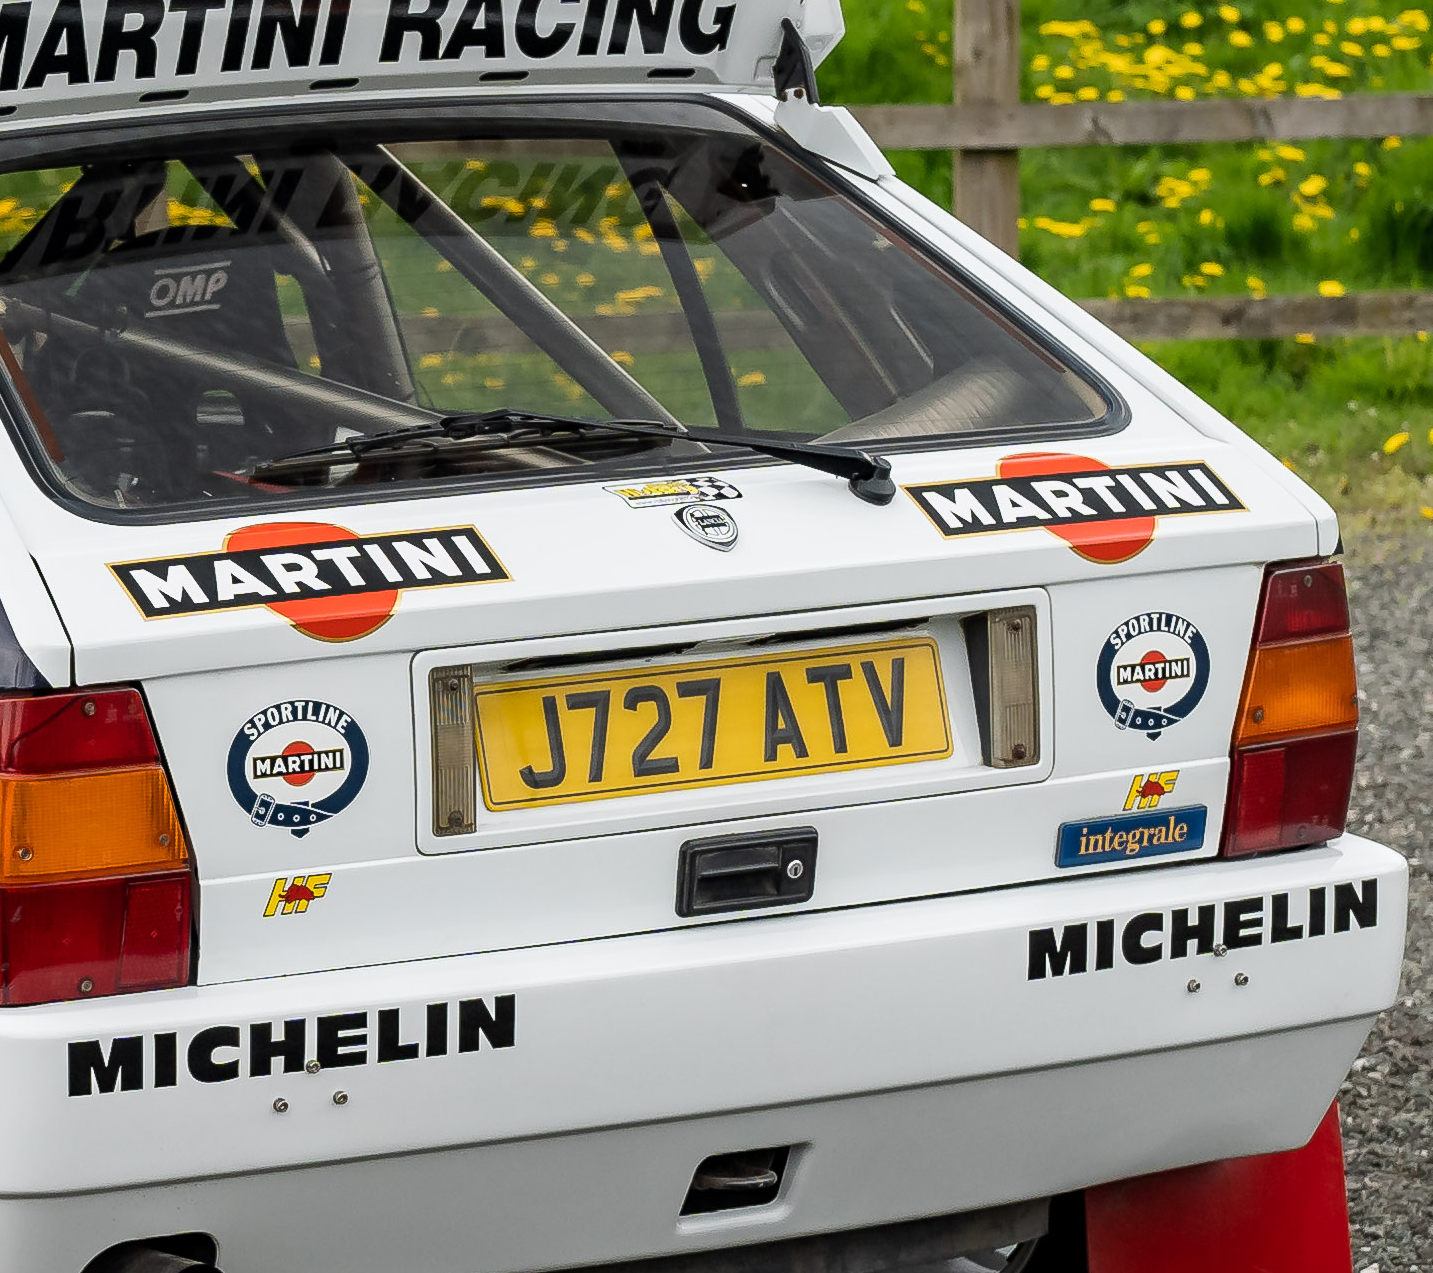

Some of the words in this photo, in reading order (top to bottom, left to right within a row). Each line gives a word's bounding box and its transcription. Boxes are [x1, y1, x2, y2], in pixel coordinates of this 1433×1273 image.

[150, 270, 228, 307] OMP
[920, 466, 1230, 531] MARTINI
[129, 527, 491, 609] MARTINI
[1110, 613, 1197, 650] SPORTLINE
[1119, 660, 1188, 683] MARTINI
[243, 701, 352, 741] SPORTLINE
[519, 677, 722, 789] J727
[764, 657, 906, 762] ATV
[256, 751, 341, 776] MARTINI
[1078, 815, 1188, 855] integrale
[1026, 878, 1379, 981] MICHELIN
[67, 993, 516, 1097] MICHELIN
